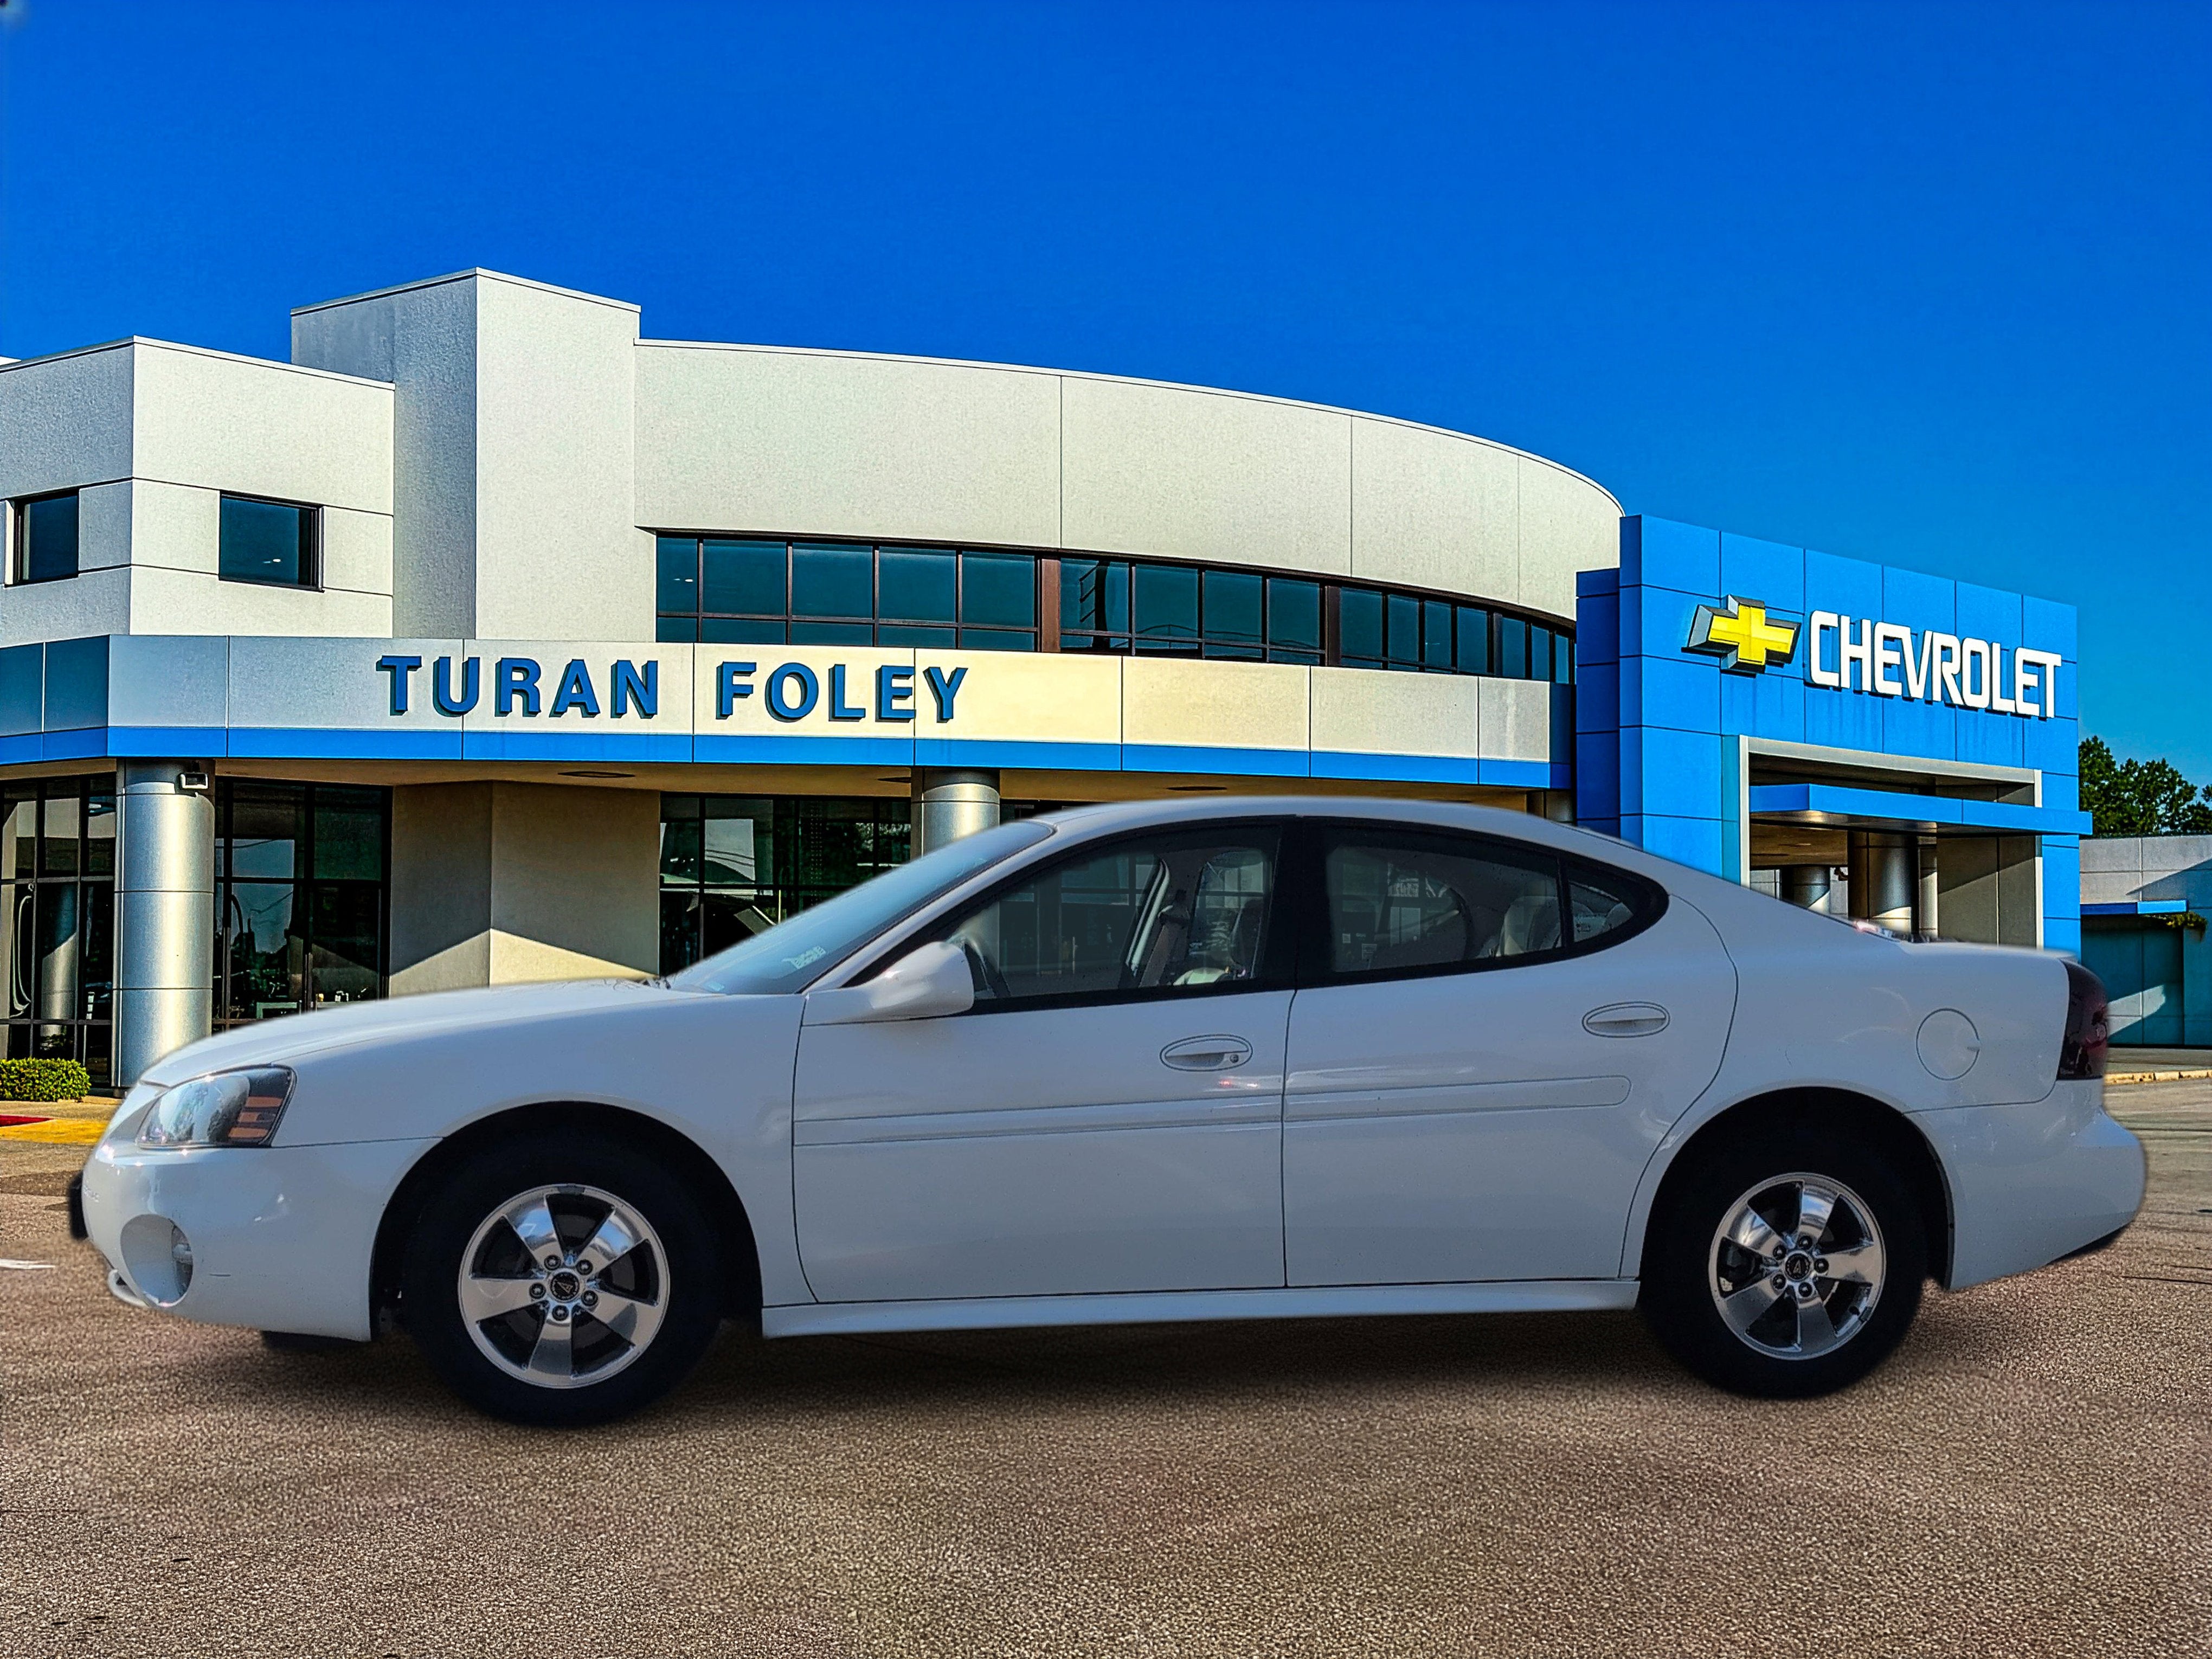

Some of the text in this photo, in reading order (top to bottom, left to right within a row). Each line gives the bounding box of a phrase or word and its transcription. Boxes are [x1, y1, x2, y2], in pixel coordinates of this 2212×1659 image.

[376, 655, 968, 723] TURAN FOLEY
[1811, 610, 2061, 718] CHEVROLET
